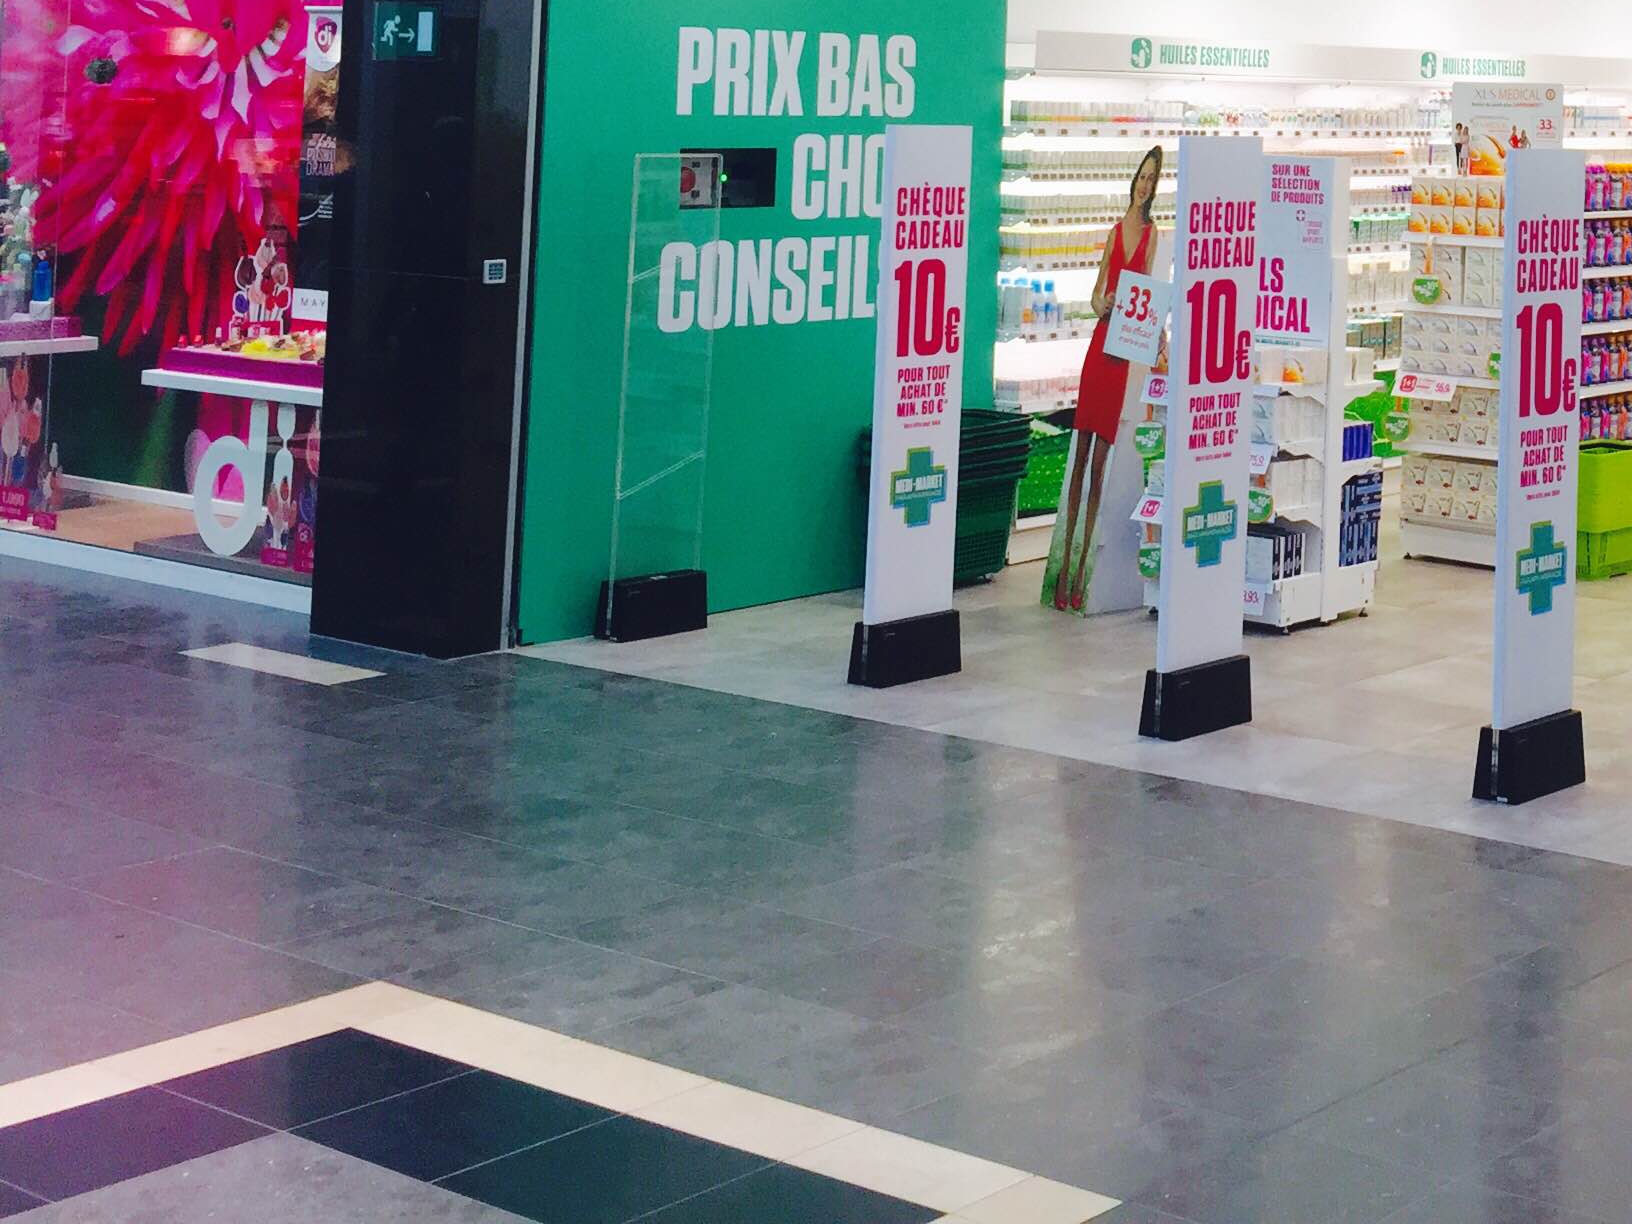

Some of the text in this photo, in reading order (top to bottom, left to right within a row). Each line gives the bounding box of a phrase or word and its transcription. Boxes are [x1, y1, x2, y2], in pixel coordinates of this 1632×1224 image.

[1159, 44, 1270, 69] HUILES ESSENTIELLES
[1442, 56, 1527, 78] HUILES ESSENTIELLES
[676, 26, 918, 119] PRIX BAS
[1272, 163, 1311, 177] SUR UNE
[897, 181, 966, 218] CHÈQUE
[1271, 191, 1324, 205] DE PRODUITS
[1189, 196, 1257, 235] CHÈQUE
[895, 220, 964, 251] CADEAU
[1517, 213, 1580, 255] CHÈQUE
[1187, 237, 1255, 270] CADEAU
[1516, 257, 1579, 294] CADEAU
[894, 258, 961, 358] 10€
[1186, 278, 1252, 386] 10€
[897, 365, 951, 383] POUR TOUT
[1516, 302, 1577, 418] 10€
[900, 382, 946, 400] ACHAT DE
[1189, 392, 1241, 414] POUR TOUT
[1192, 411, 1237, 431] ACHAT DE
[1520, 425, 1568, 448] POUR TOUT
[1523, 445, 1565, 468] ACHAT DE
